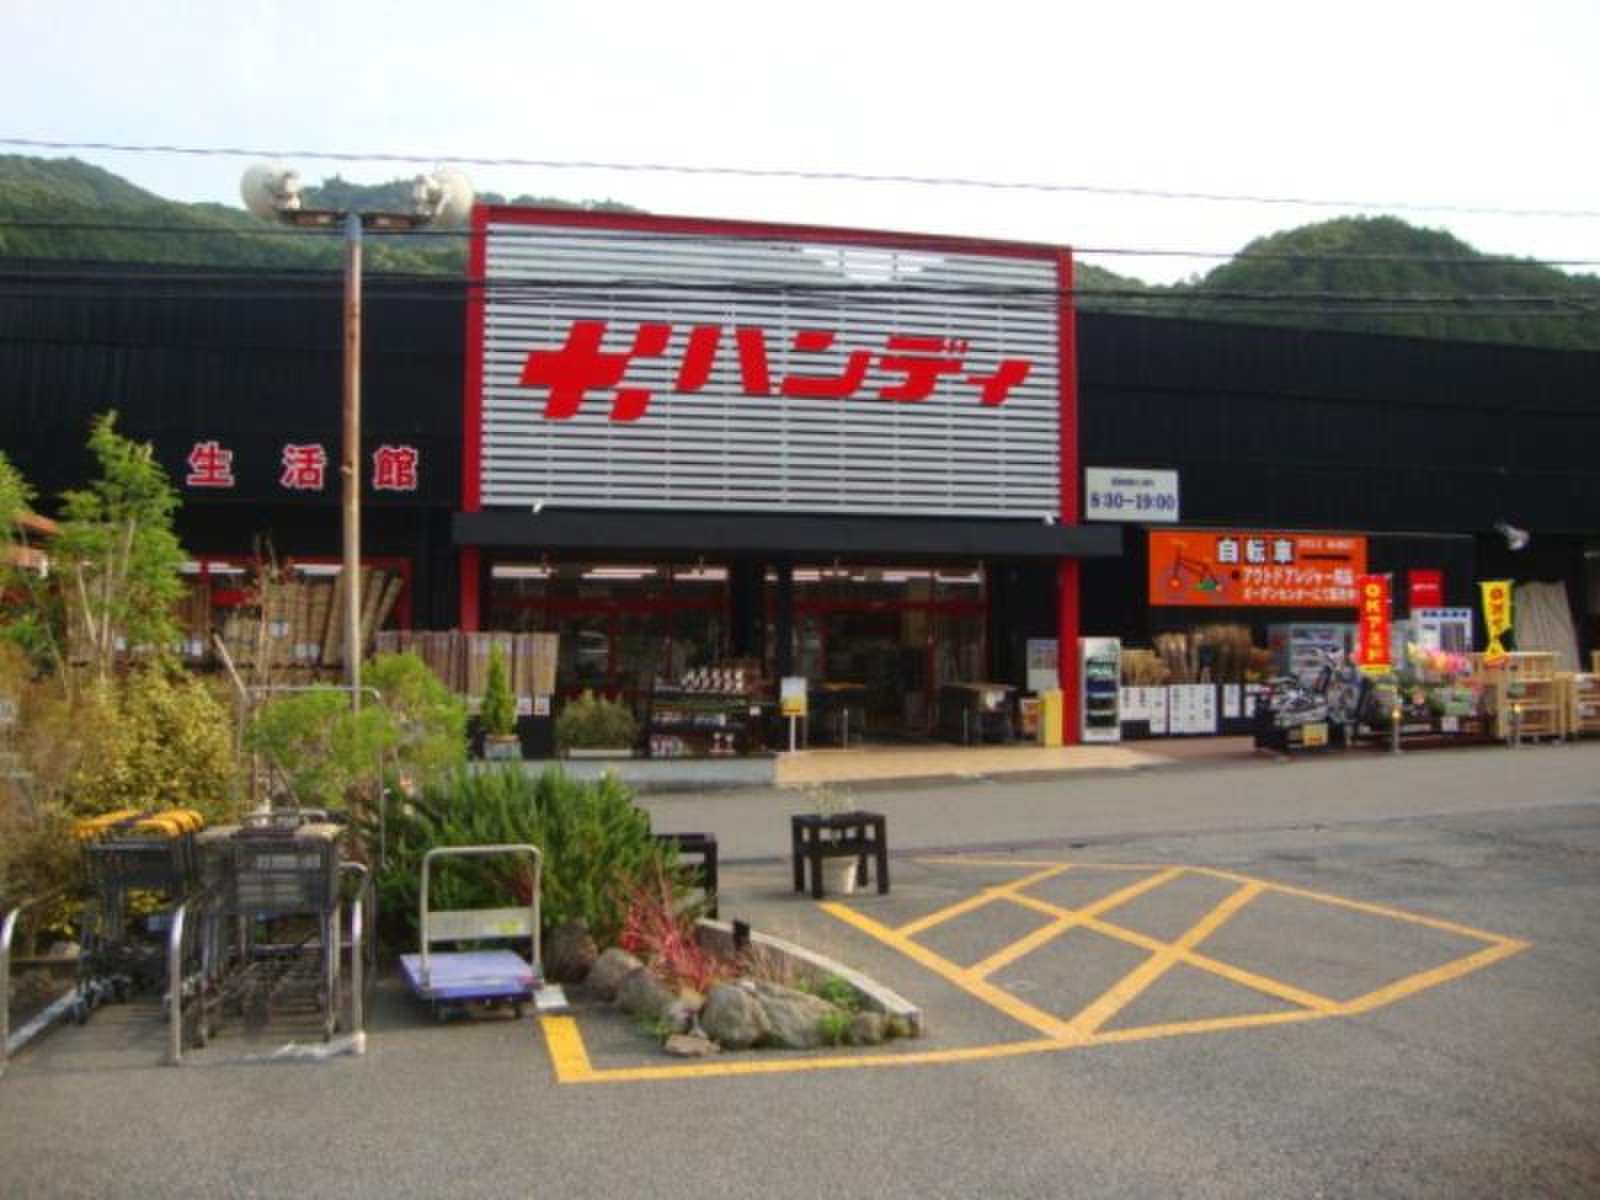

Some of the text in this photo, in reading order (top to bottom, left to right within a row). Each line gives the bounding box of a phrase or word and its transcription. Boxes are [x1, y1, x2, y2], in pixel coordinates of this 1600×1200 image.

[674, 325, 1032, 406] ハンディ
[186, 441, 419, 490] 生活館
[1216, 537, 1294, 564] 自転車
